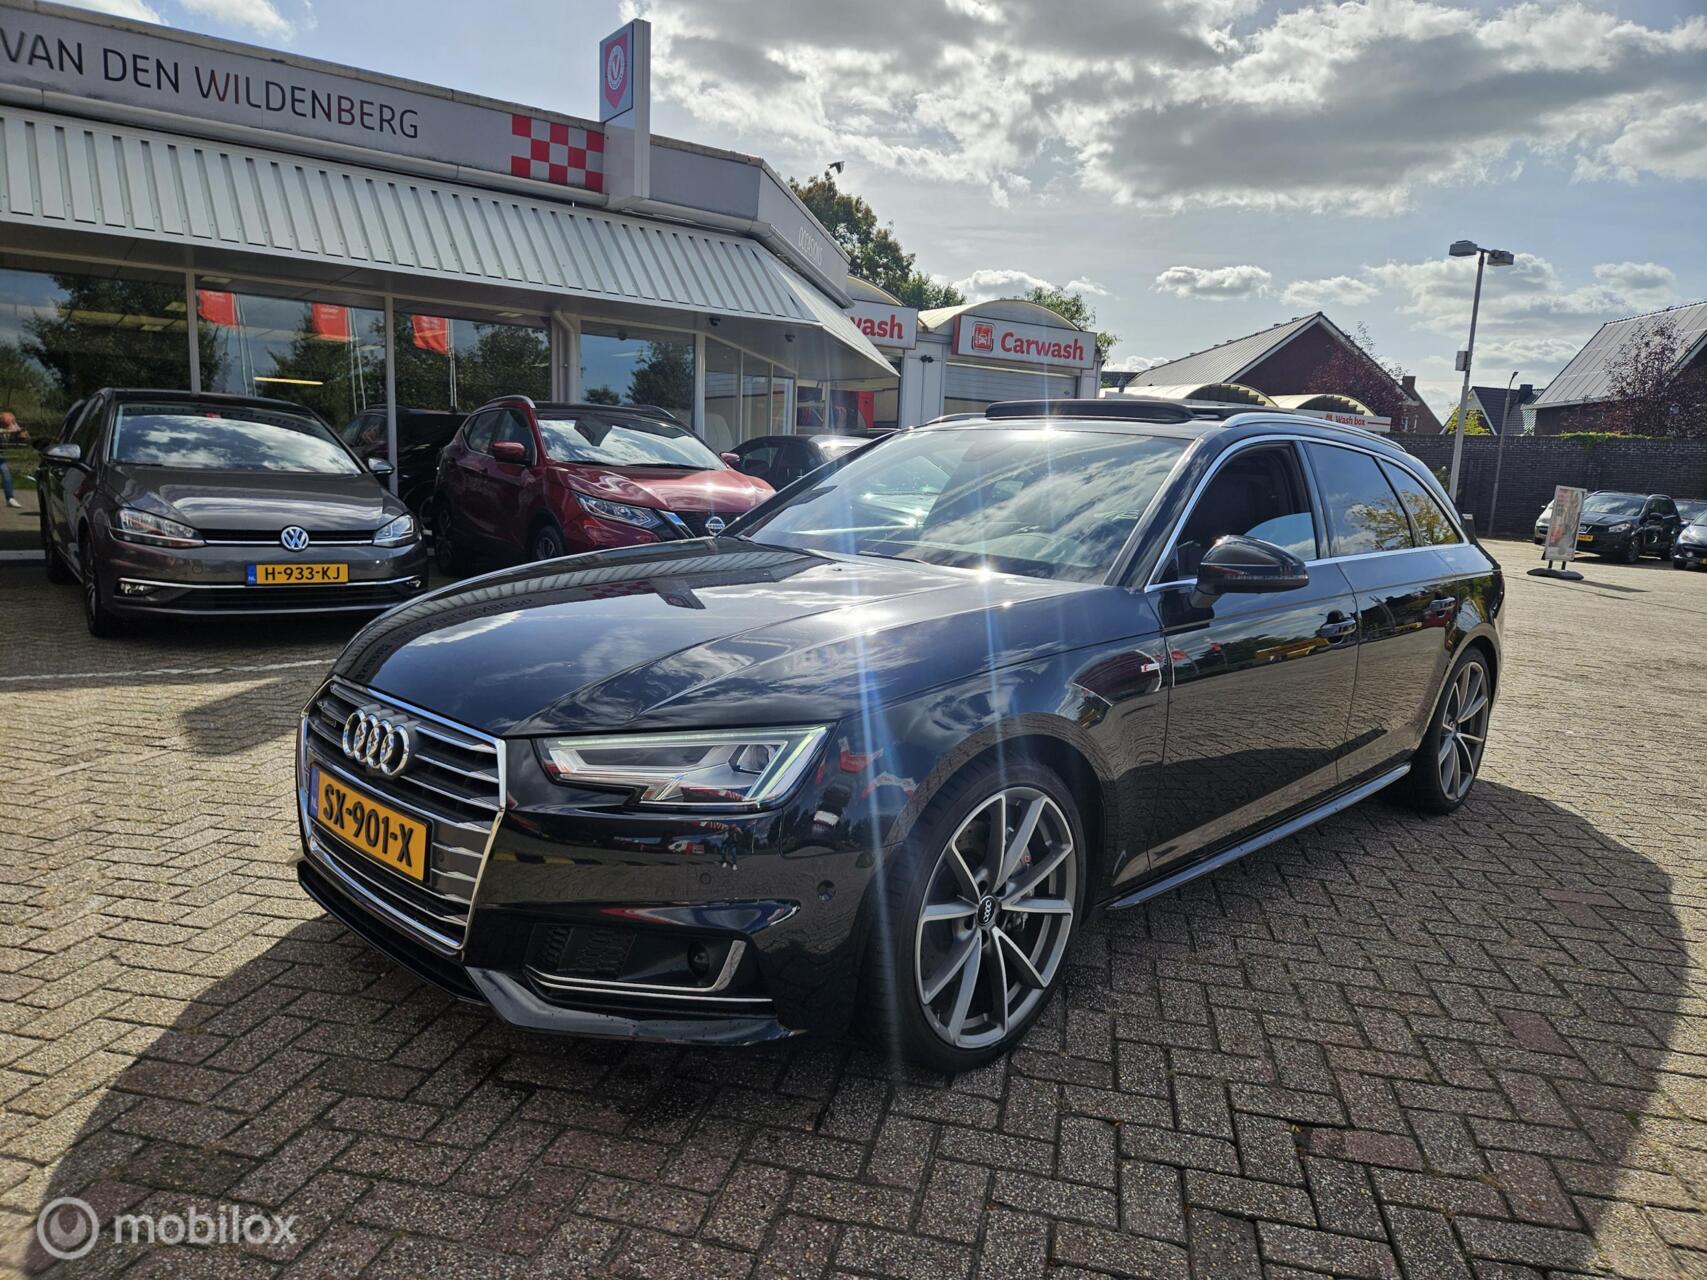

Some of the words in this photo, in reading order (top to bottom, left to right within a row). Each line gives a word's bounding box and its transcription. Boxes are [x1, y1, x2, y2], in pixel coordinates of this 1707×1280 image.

[0, 27, 84, 75] VAN
[103, 48, 180, 93] DEN
[195, 66, 418, 139] WILDENBERG
[1000, 331, 1084, 361] Carwash
[1335, 415, 1353, 424] Wash
[1354, 416, 1366, 426] box
[264, 566, 340, 581] H-933-KJ
[323, 783, 414, 868] SX-901-X
